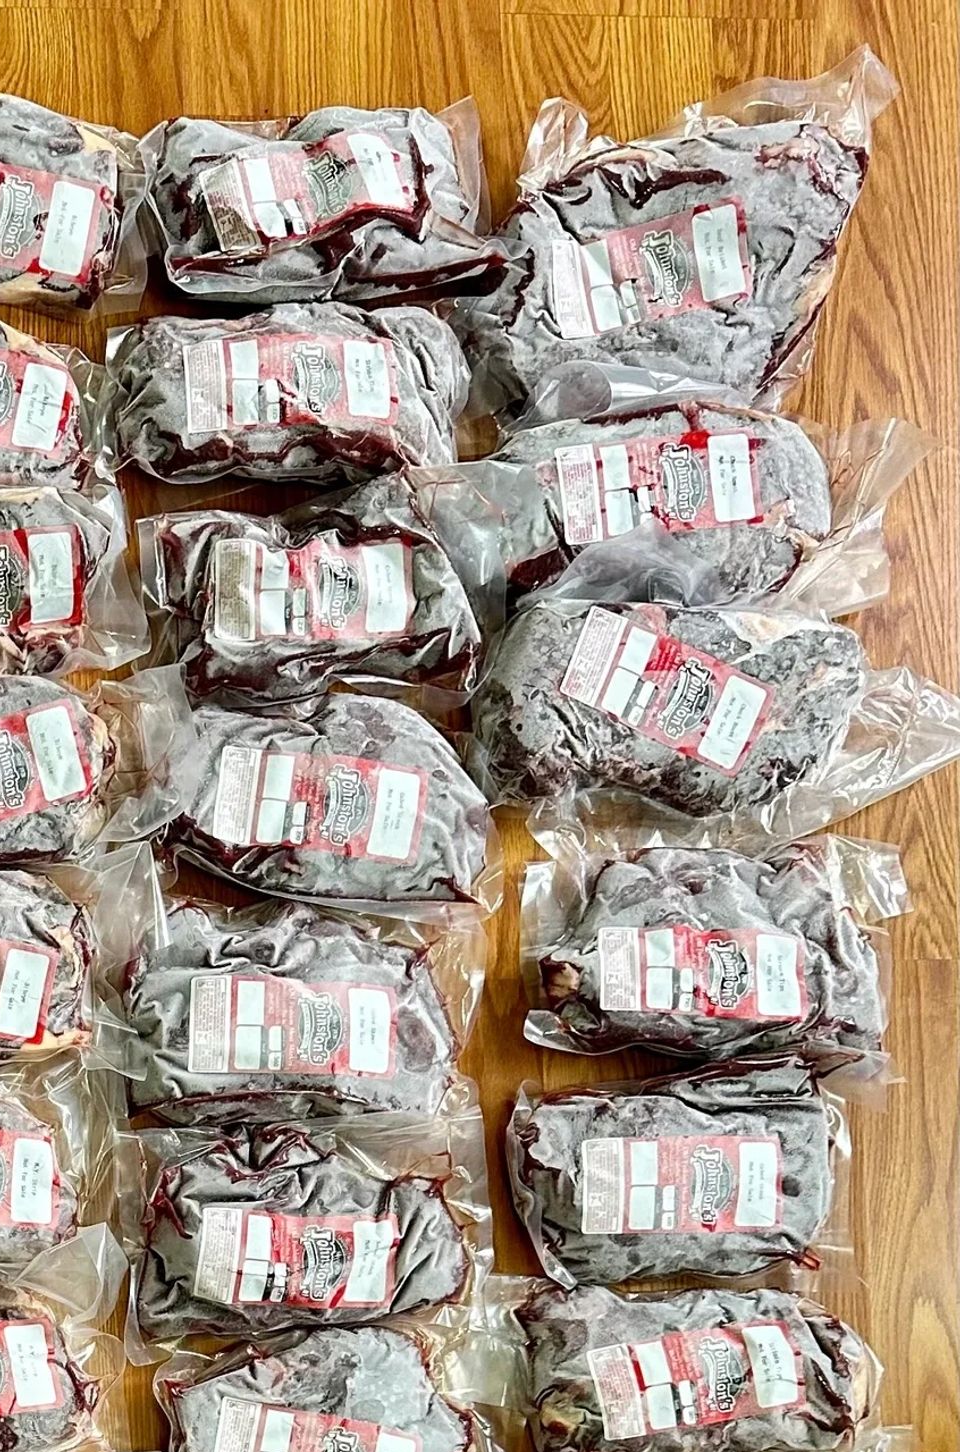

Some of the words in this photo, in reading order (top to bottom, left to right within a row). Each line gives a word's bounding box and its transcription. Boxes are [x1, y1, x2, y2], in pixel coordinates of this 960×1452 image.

[653, 233, 680, 307] Johnston's
[669, 448, 694, 520] Johnston's
[664, 664, 708, 740] Johnston's
[330, 770, 355, 845] Johnston's
[716, 944, 736, 1007] Johnston's
[306, 995, 329, 1064] Johnston's
[310, 1232, 333, 1299] Johnston's
[708, 1340, 732, 1411] Johnston's
